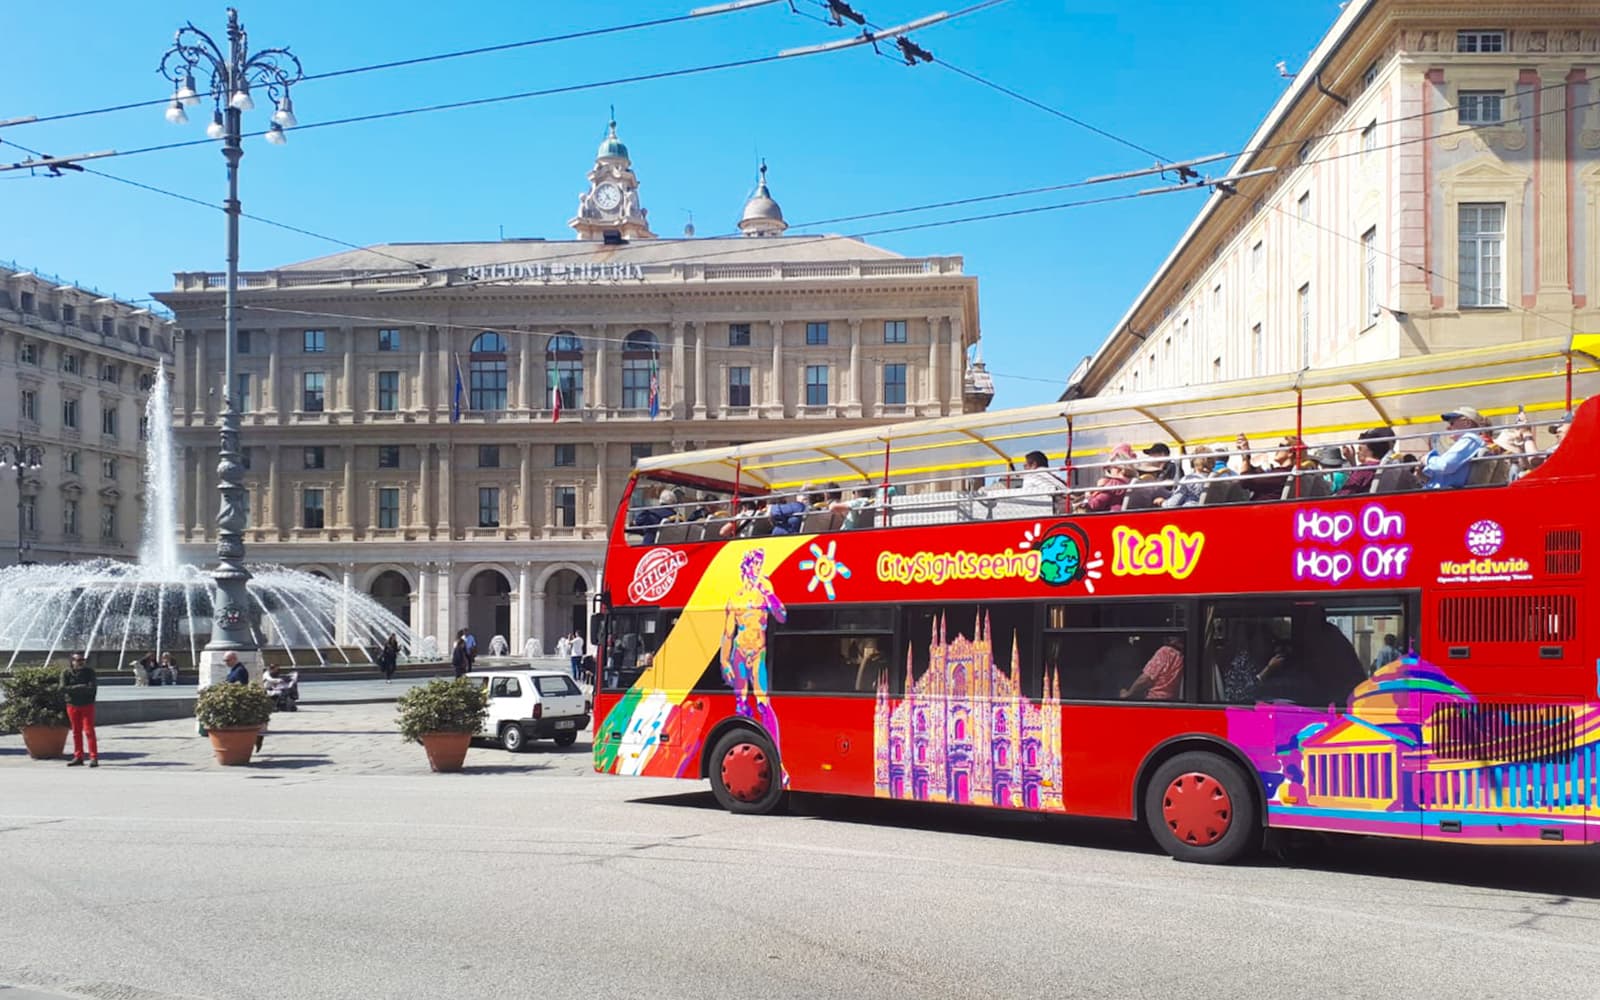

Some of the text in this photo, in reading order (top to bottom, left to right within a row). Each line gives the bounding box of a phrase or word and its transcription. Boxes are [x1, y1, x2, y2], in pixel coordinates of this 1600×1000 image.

[467, 262, 644, 280] REGIONE LIGURIA
[1297, 505, 1402, 542] Hop On
[877, 549, 1041, 584] CitySightseeing
[1112, 525, 1204, 578] Italy
[1296, 546, 1410, 582] Hop Off
[1440, 558, 1529, 575] Worldwide
[634, 554, 684, 596] OFFICIAL
